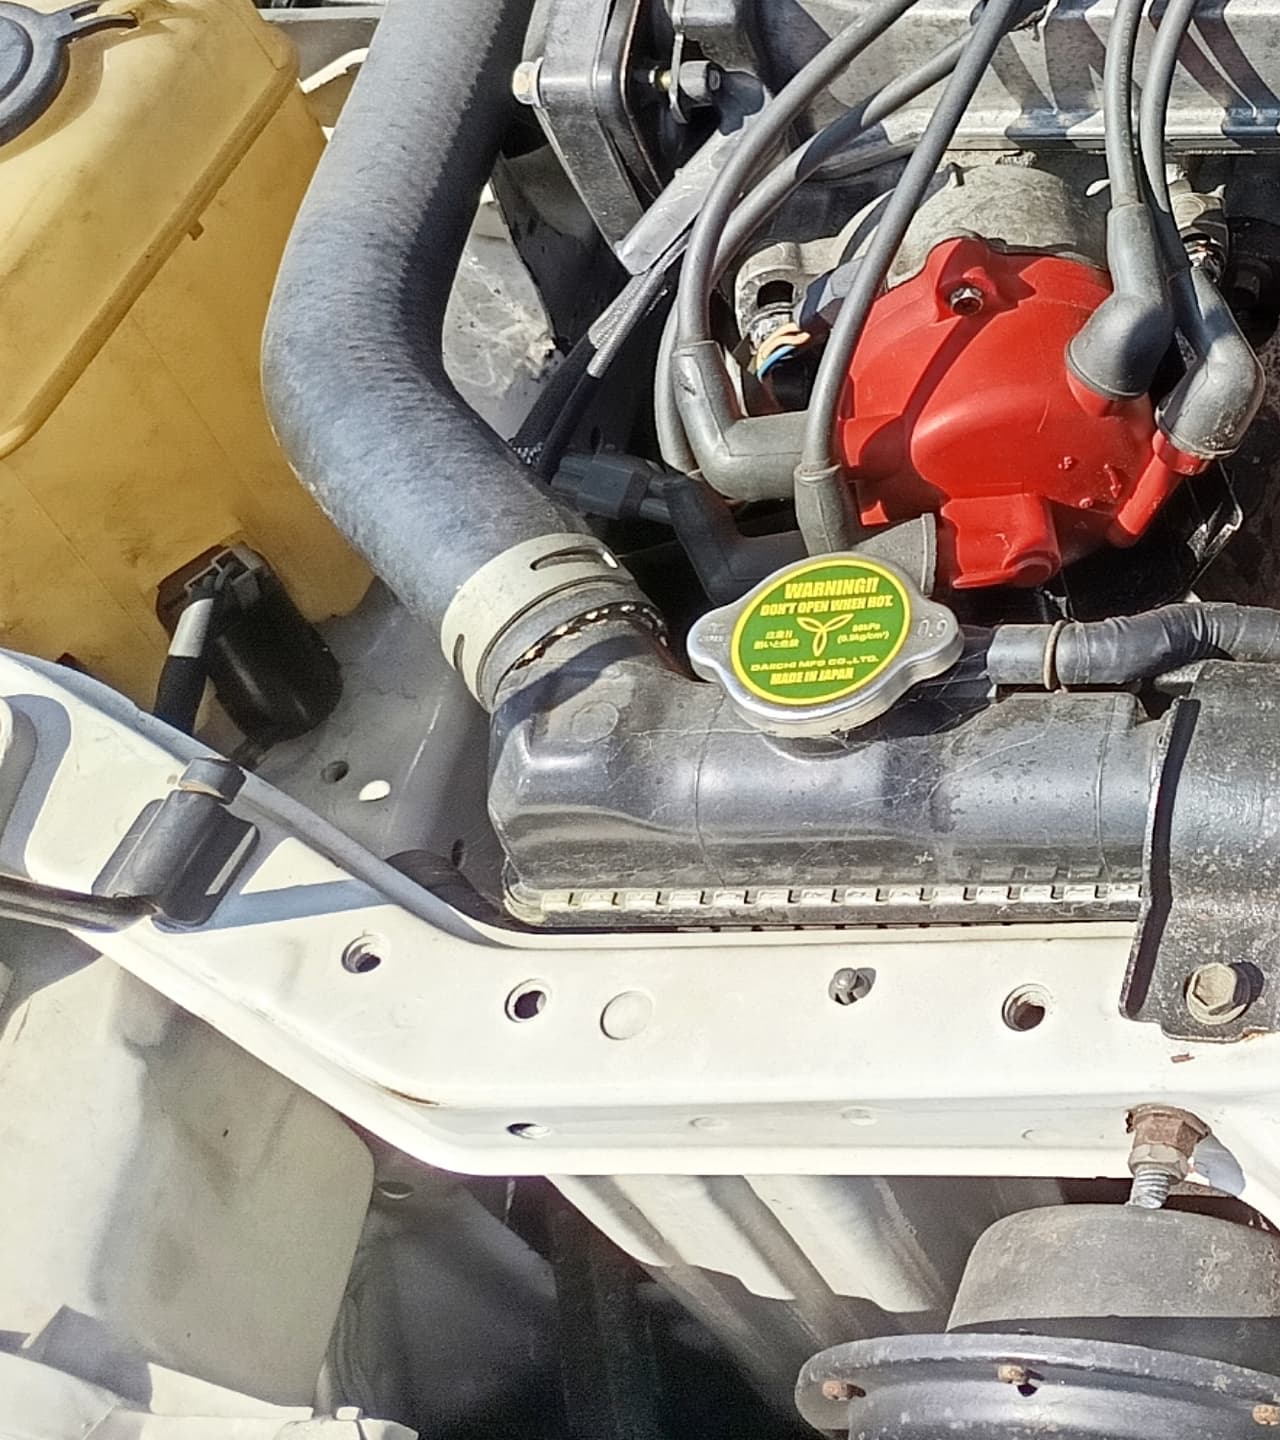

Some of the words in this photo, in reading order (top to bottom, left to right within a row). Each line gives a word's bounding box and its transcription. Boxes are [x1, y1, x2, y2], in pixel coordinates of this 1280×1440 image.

[784, 577, 880, 600] WARNING!!
[760, 602, 795, 617] DON'T
[797, 599, 830, 614] OPEN
[831, 596, 866, 612] WHEN
[867, 594, 894, 609] HOT.
[916, 619, 948, 638] 0.9
[770, 672, 803, 685] MADE
[804, 670, 817, 683] IN
[818, 667, 854, 682] JAPAN
